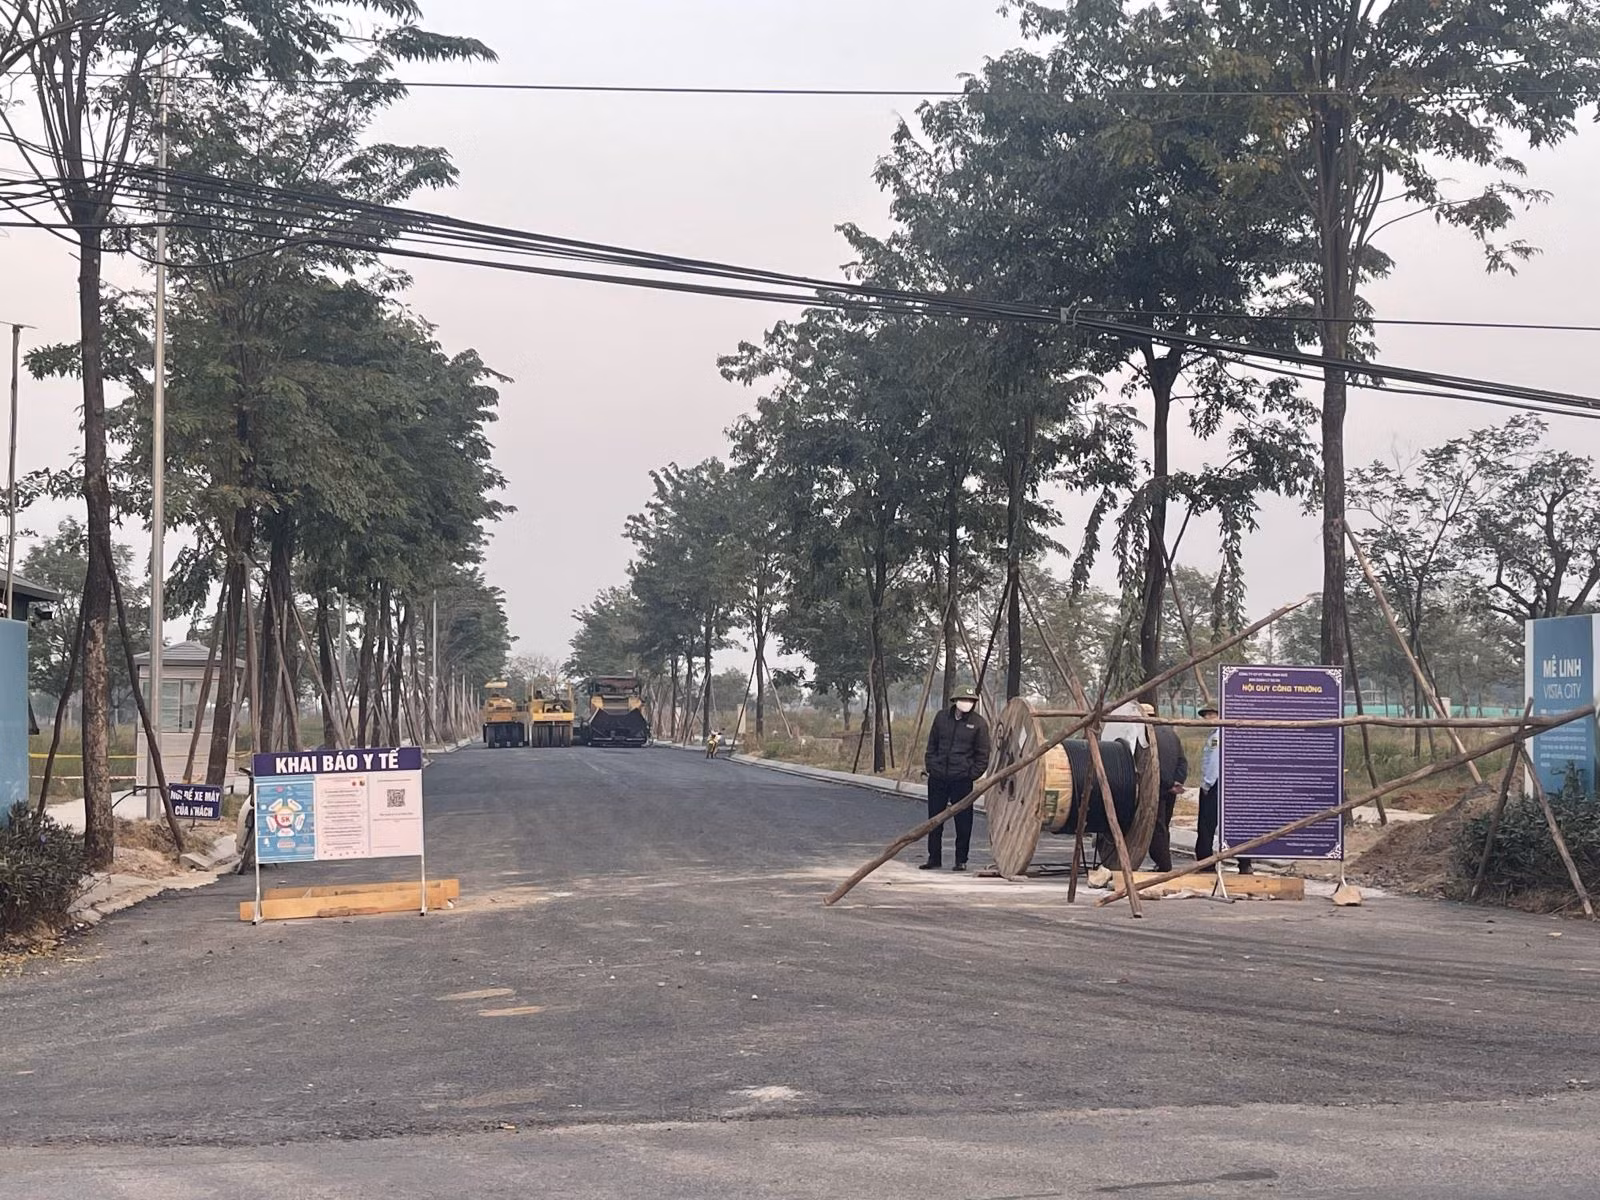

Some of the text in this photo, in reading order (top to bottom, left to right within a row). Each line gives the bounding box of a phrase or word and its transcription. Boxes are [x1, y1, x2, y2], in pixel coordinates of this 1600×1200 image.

[1543, 654, 1582, 678] MÊ LINH
[1256, 684, 1270, 692] QUY
[1272, 683, 1292, 692] CÔNG
[1543, 683, 1582, 700] VISTA CITY
[275, 748, 401, 774] KHAI BÁO Y TẾ
[194, 791, 203, 801] XE
[205, 790, 220, 802] MÁY
